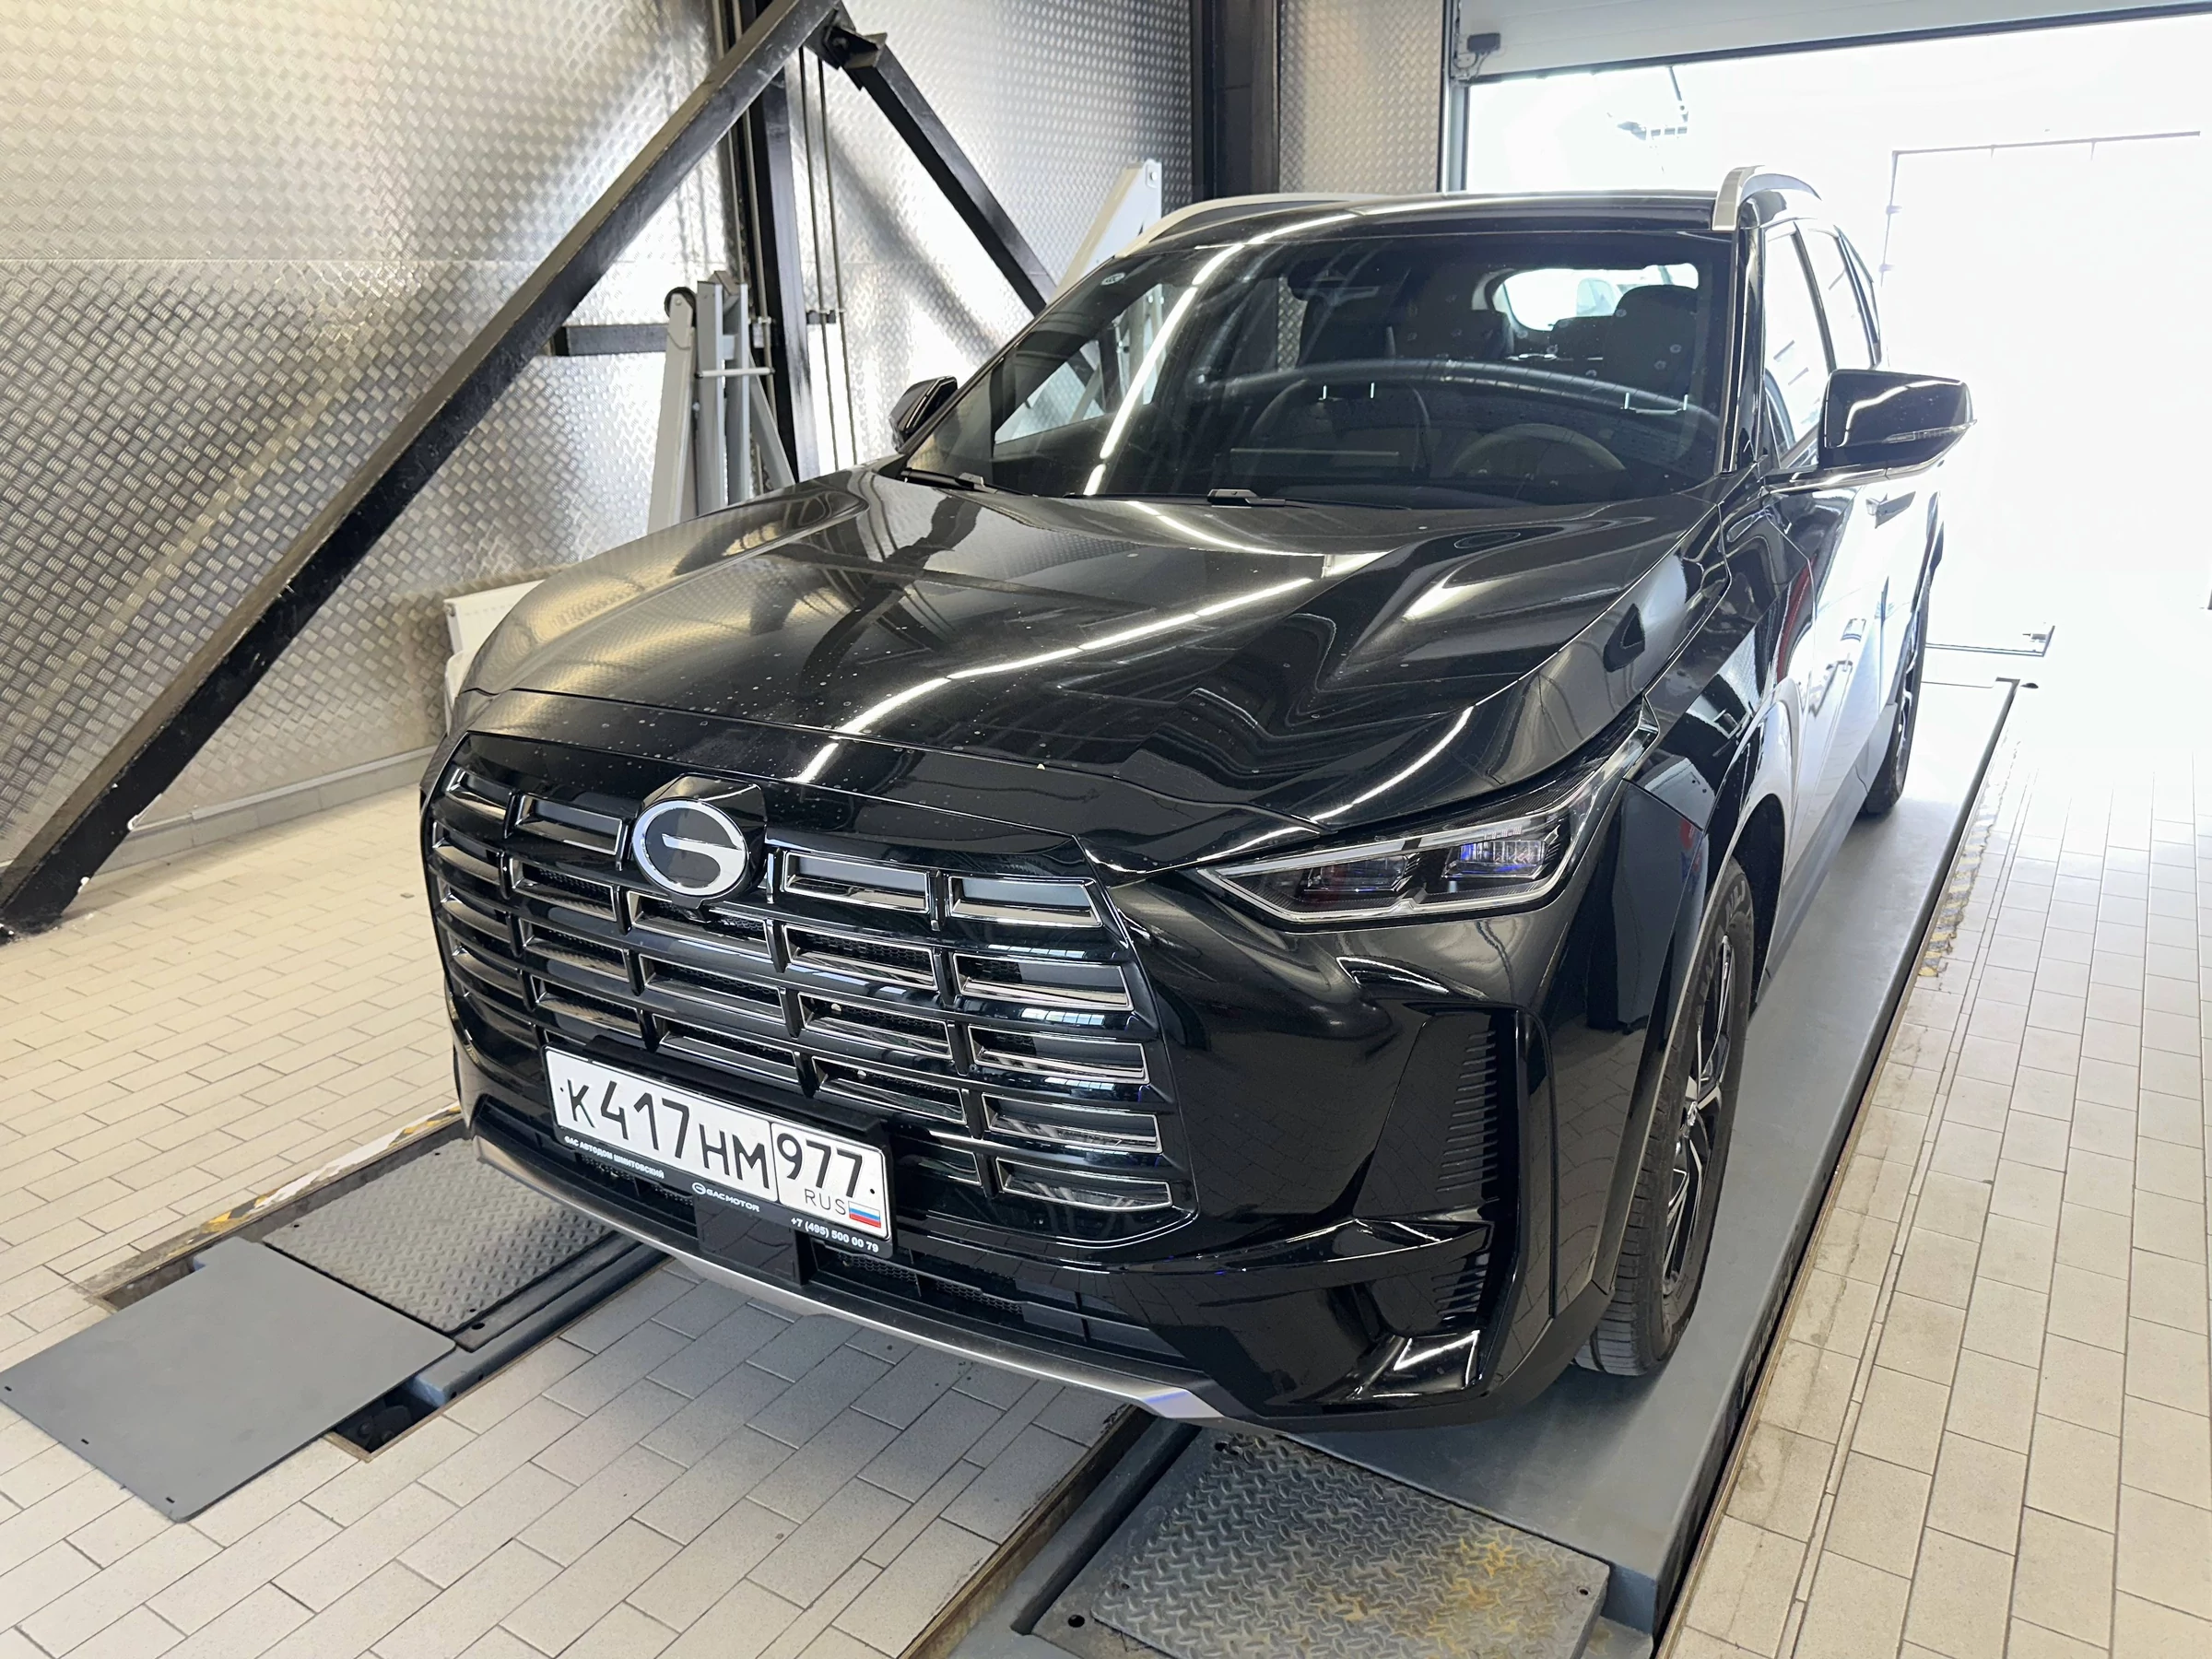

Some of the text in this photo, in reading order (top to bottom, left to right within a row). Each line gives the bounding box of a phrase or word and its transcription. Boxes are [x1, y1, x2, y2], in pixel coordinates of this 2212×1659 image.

[579, 1141, 614, 1159] АВТОДОМ
[614, 1154, 665, 1179] ШМИТОВСКИЙ
[777, 1133, 863, 1198] 977
[805, 1188, 846, 1216] RUS
[791, 1218, 879, 1253] +7 (495) 500 00 79
